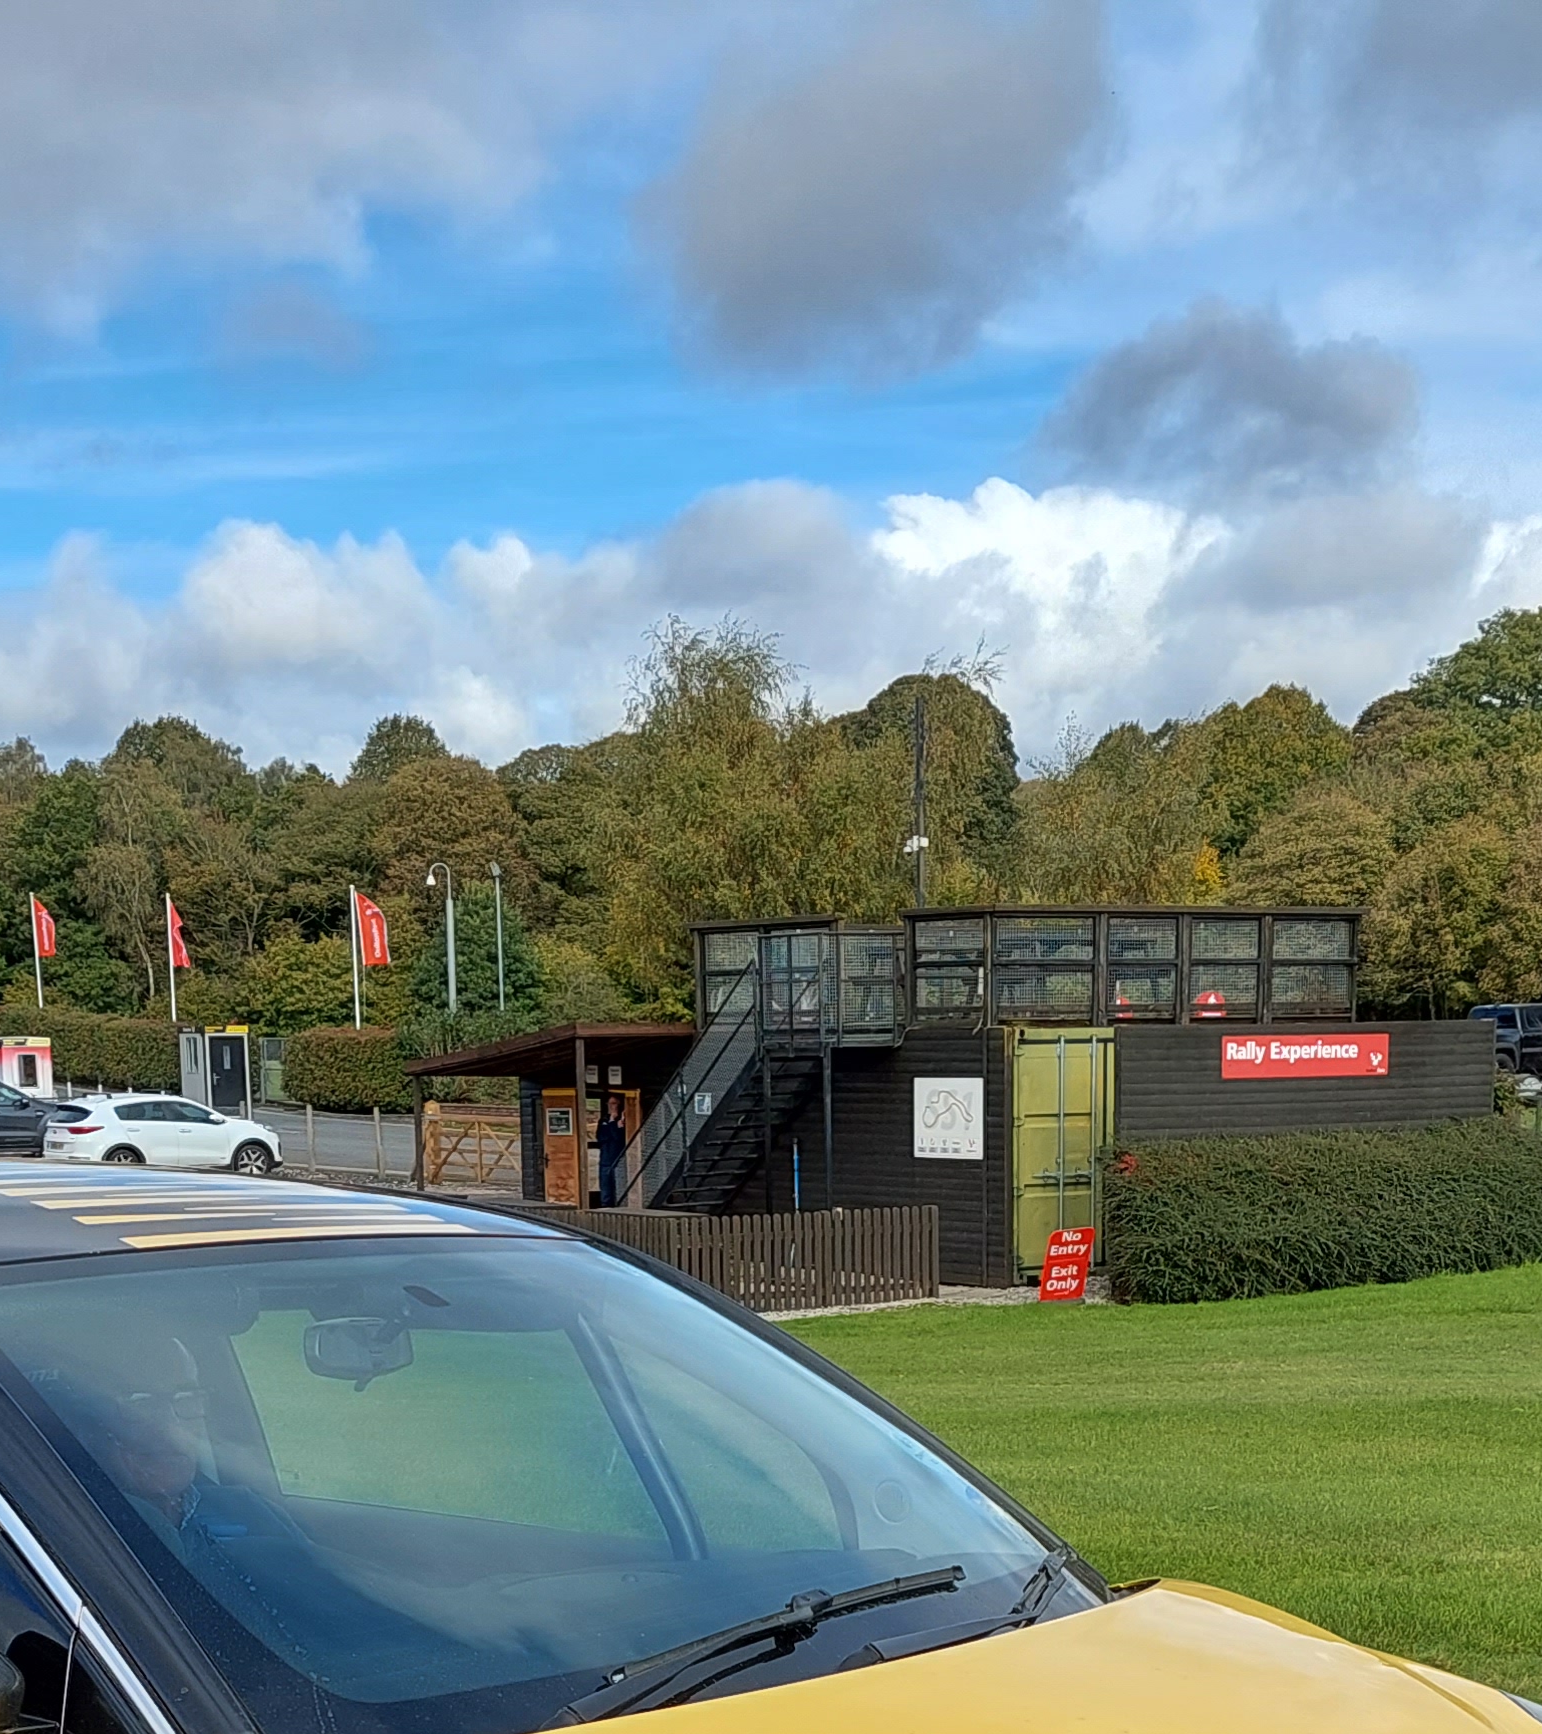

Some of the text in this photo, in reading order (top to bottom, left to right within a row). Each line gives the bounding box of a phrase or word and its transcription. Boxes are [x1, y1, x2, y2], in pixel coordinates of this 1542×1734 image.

[1226, 1040, 1359, 1064] Rally Experience
[1061, 1231, 1082, 1243] No
[1050, 1244, 1089, 1256] Entry
[1051, 1264, 1078, 1277] Exit
[1046, 1277, 1080, 1292] Only
